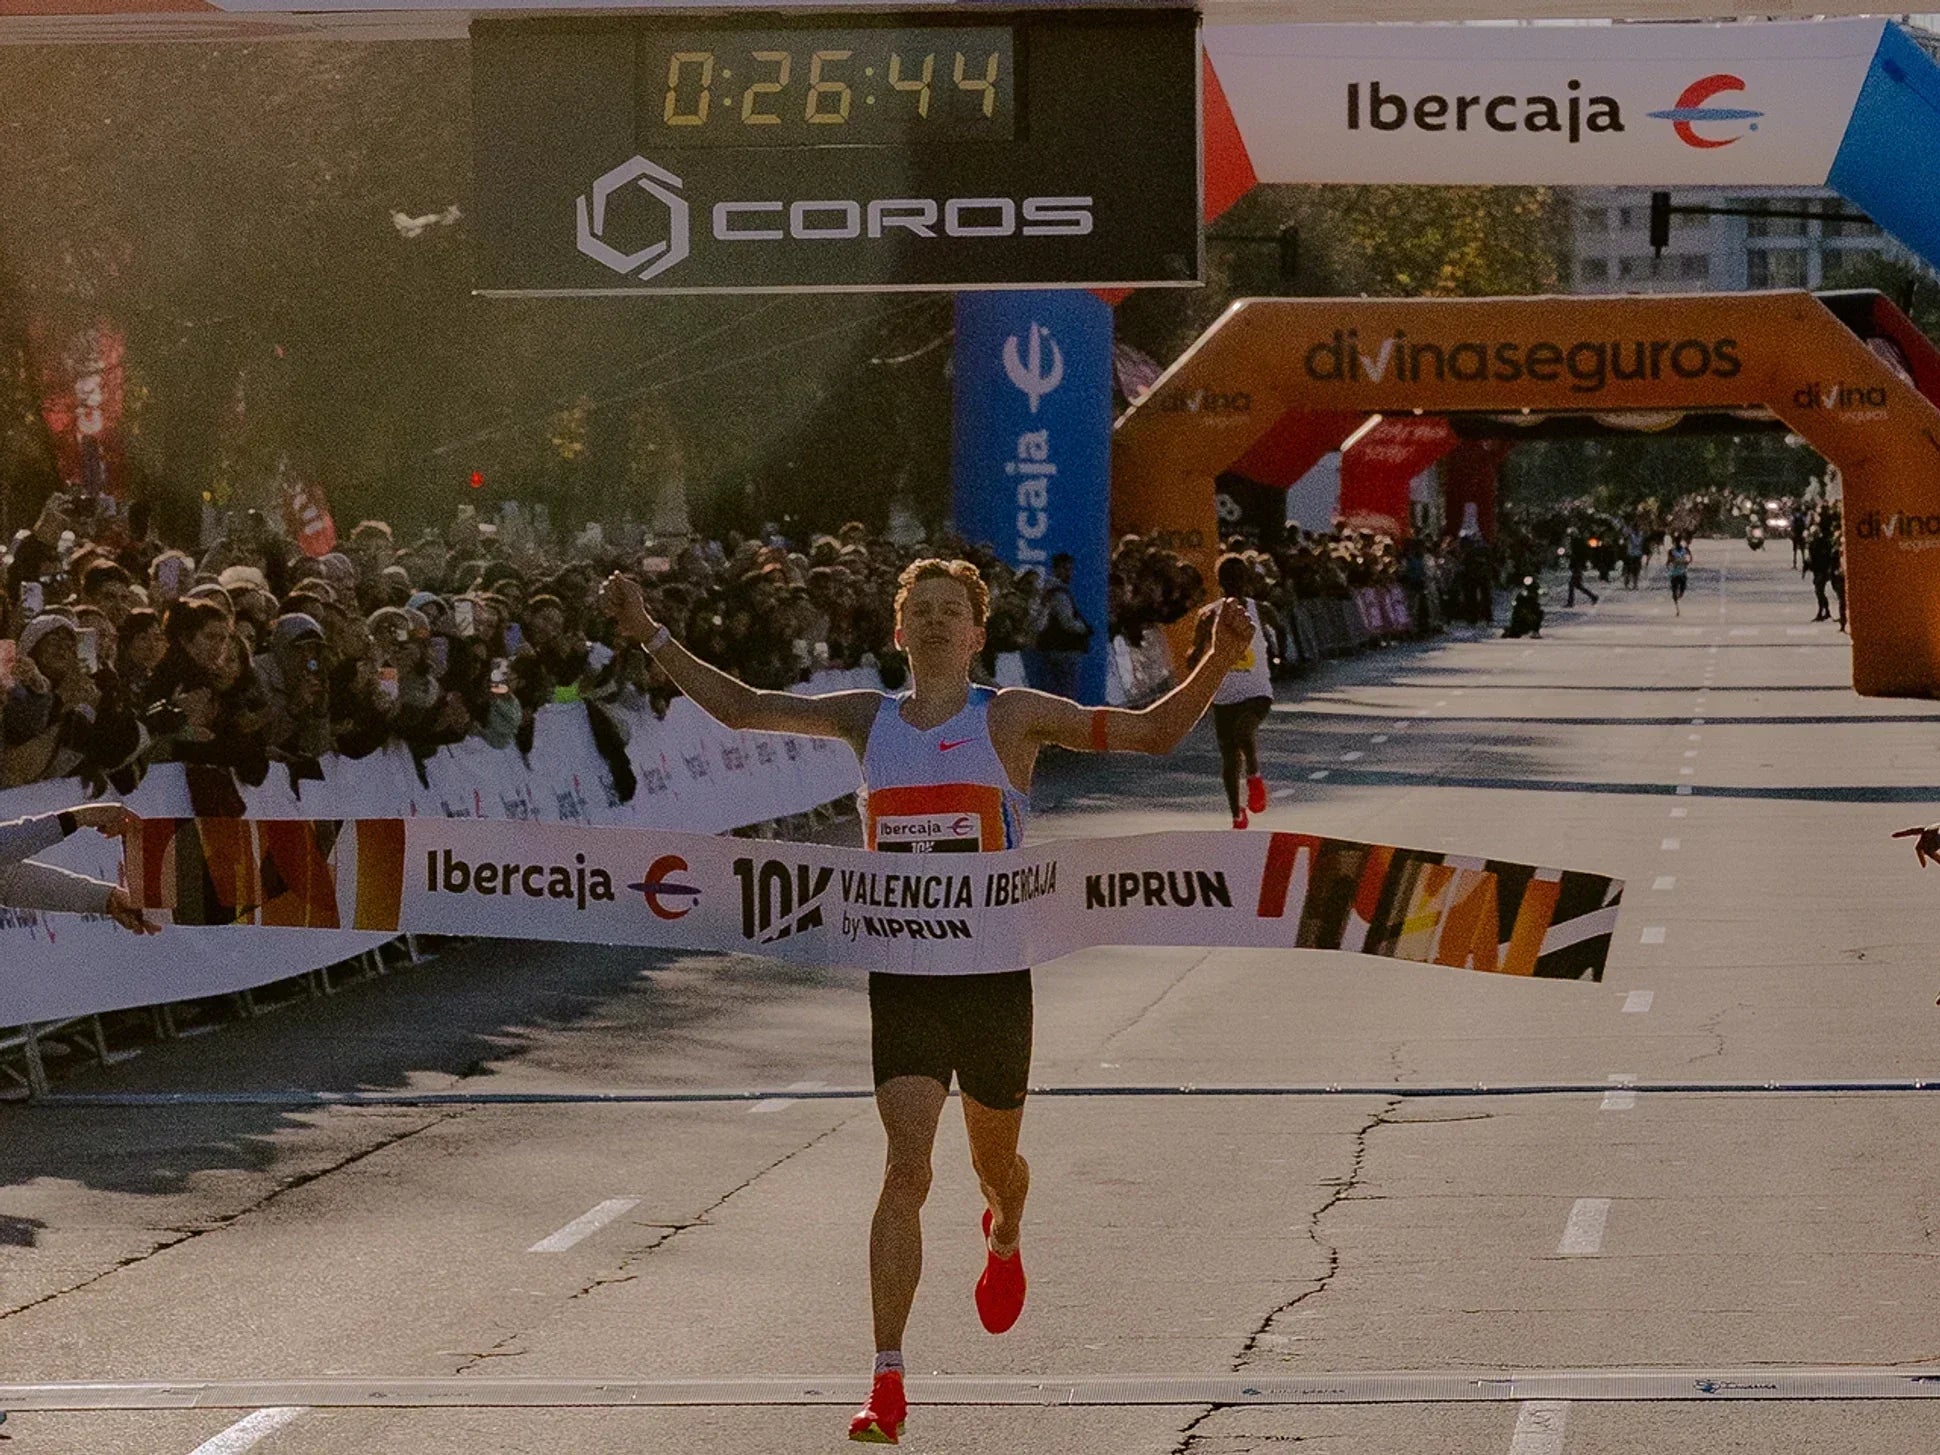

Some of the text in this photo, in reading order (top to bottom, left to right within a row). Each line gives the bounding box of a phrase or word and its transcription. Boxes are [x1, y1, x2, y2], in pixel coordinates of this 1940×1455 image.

[664, 51, 999, 126] 0:26:44
[1346, 79, 1626, 144] Ibercaja
[712, 195, 1094, 241] COROS
[1304, 329, 1743, 394] divinaseguros
[1793, 380, 1887, 410] divina
[880, 820, 943, 837] Ibercaja
[427, 849, 616, 911] Ibercaja
[733, 857, 835, 945] 10K
[840, 860, 1057, 909] VALENCIA IBERCAJA
[1085, 870, 1234, 910] KIPRUN
[842, 909, 973, 942] by KIPRUN
